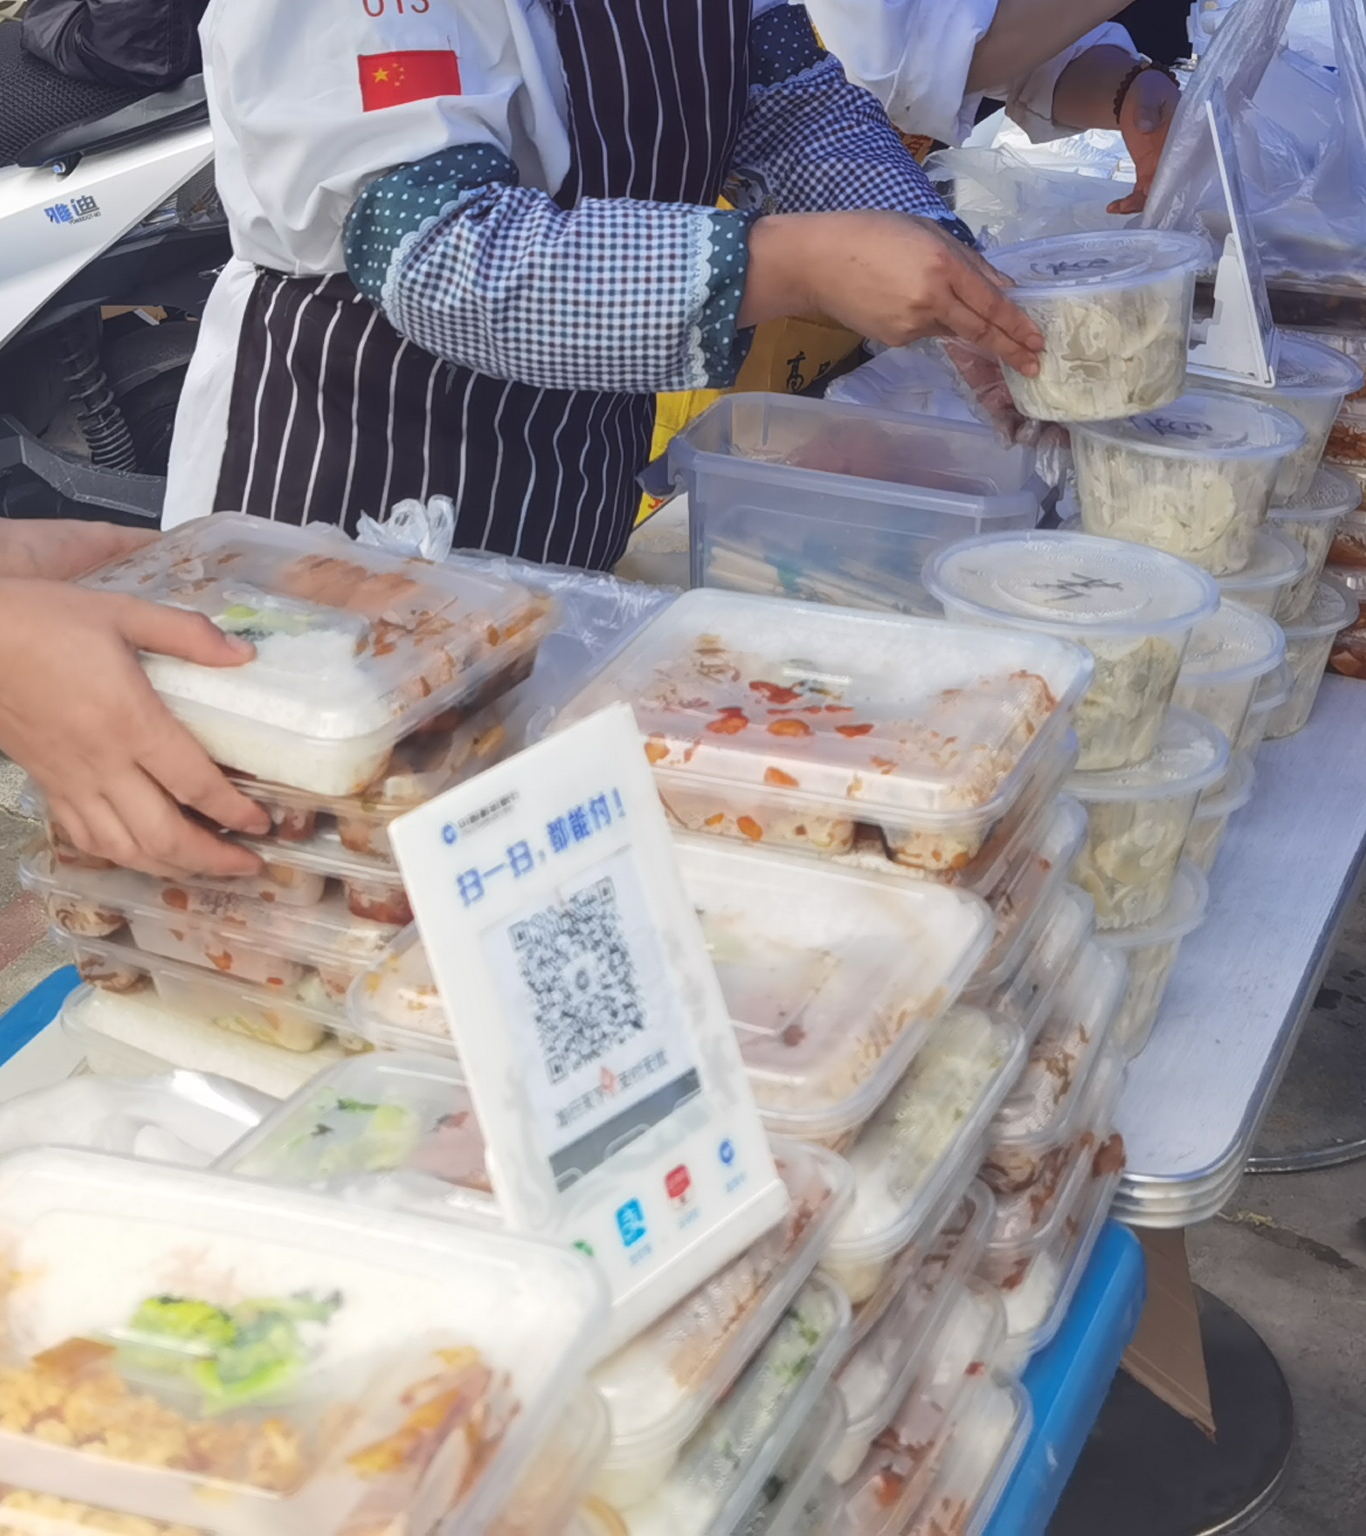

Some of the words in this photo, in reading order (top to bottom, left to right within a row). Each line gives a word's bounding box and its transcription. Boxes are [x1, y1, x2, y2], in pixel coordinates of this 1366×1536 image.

[43, 195, 101, 225] 雅迪
[456, 786, 627, 908] 扫一扫，都能付！
